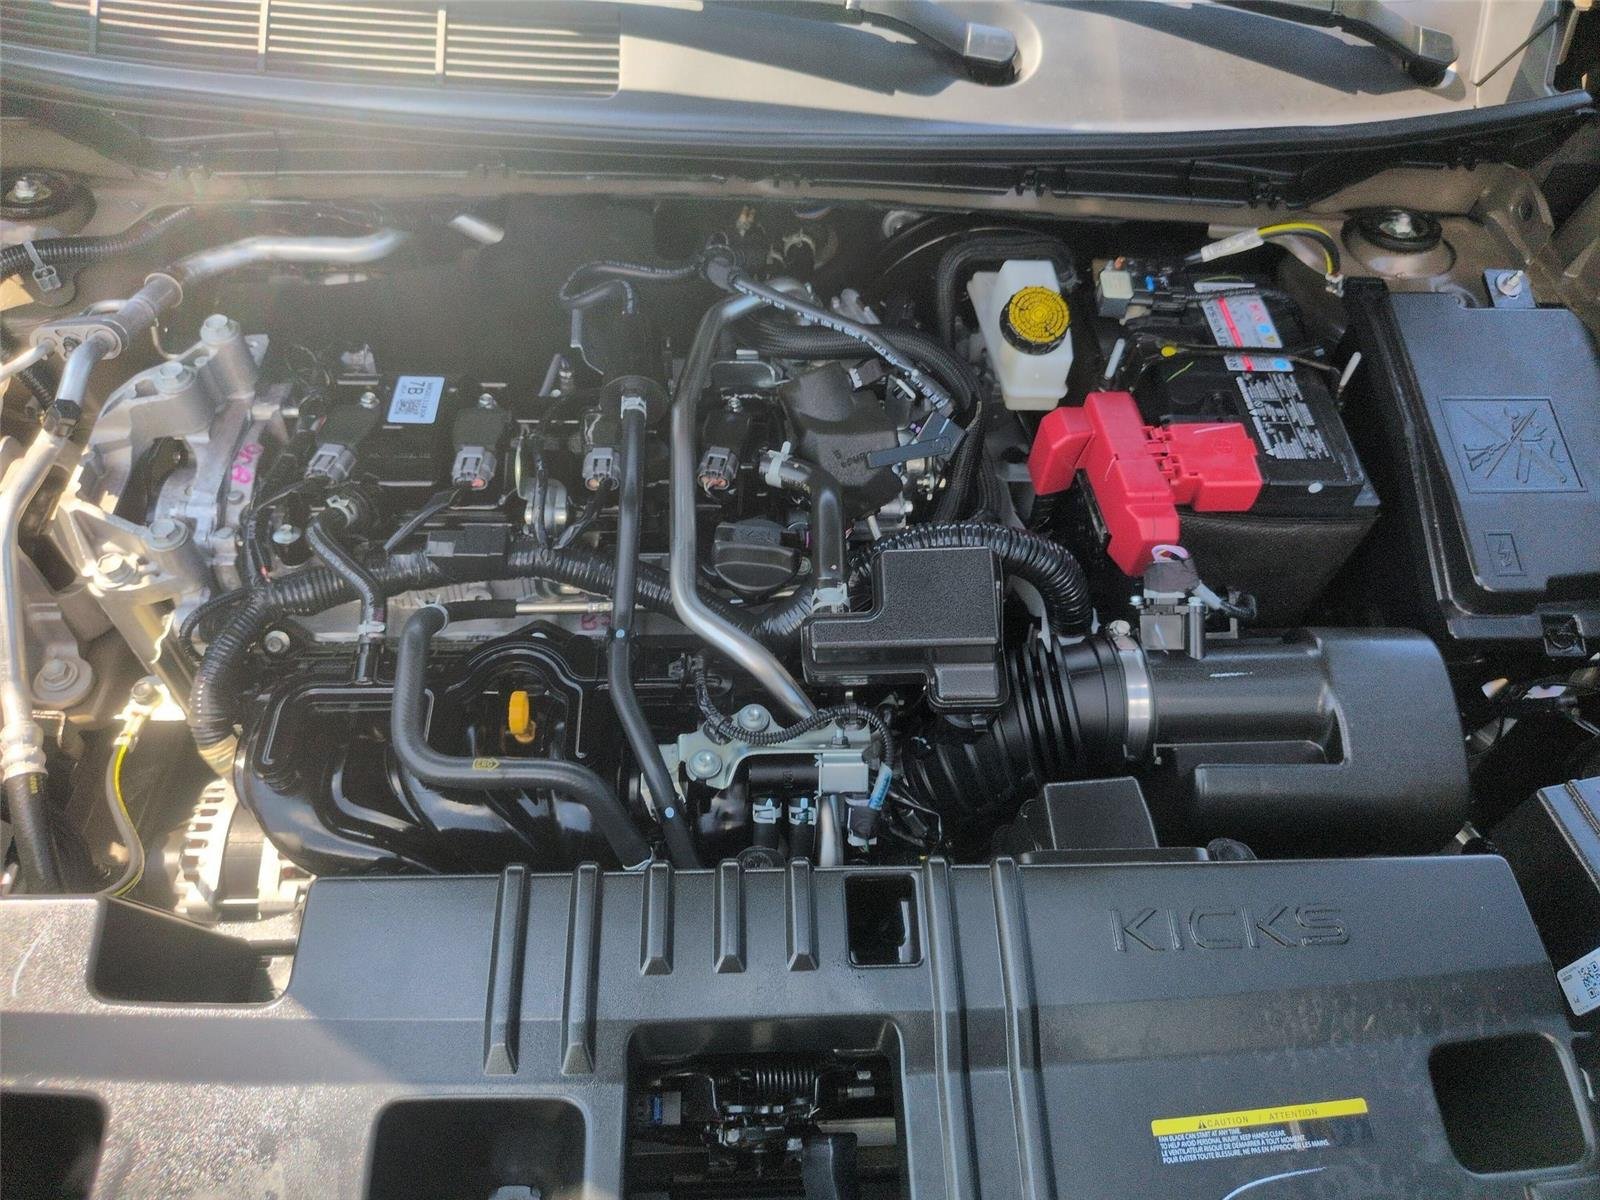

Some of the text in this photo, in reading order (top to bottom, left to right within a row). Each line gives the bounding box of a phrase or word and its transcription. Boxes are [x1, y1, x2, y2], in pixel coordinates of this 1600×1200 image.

[1110, 904, 1350, 952] KICKS
[1207, 1116, 1249, 1127] CAUTION
[1269, 1108, 1318, 1121] ATTENTION
[1168, 1140, 1181, 1149] HELP
[1181, 1138, 1197, 1147] AVOID
[1197, 1135, 1222, 1146] PERSONAL
[1239, 1133, 1252, 1141] KEEP
[1251, 1130, 1270, 1140] HANDS
[1169, 1133, 1186, 1142] BLADE
[1185, 1132, 1197, 1140] CAN
[1196, 1130, 1211, 1139] START
[1162, 1155, 1179, 1164] POUR
[1196, 1150, 1215, 1161] TOUTE
[1269, 1141, 1303, 1152] APPROCHER
[1168, 1145, 1204, 1156] VENTILATEUR
[1203, 1143, 1223, 1152] RISQUE
[1265, 1137, 1280, 1145] TOUT
